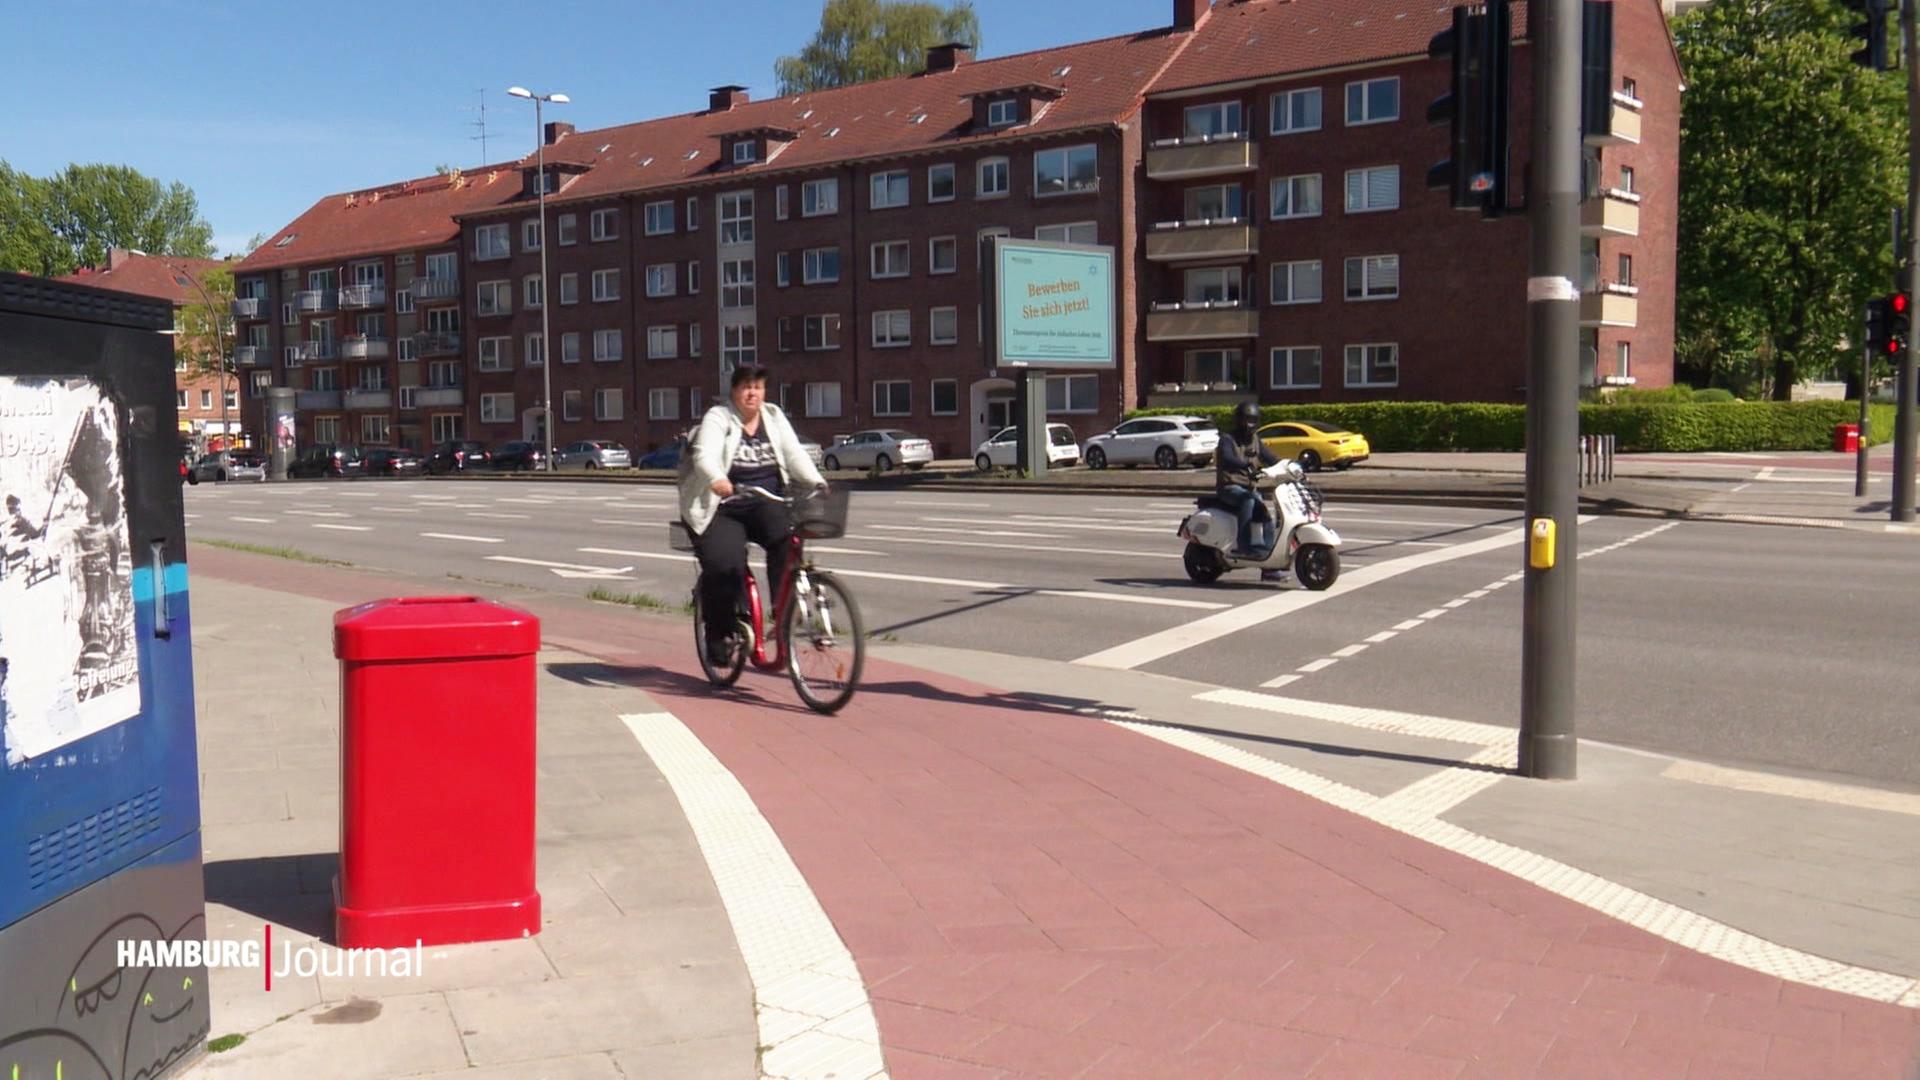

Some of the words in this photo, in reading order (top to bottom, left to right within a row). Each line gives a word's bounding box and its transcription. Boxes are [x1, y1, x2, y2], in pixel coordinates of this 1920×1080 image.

[1028, 278, 1080, 297] Bewerben
[1022, 304, 1040, 320] Sie
[1040, 300, 1062, 317] sich
[1062, 296, 1089, 316] jetzt!
